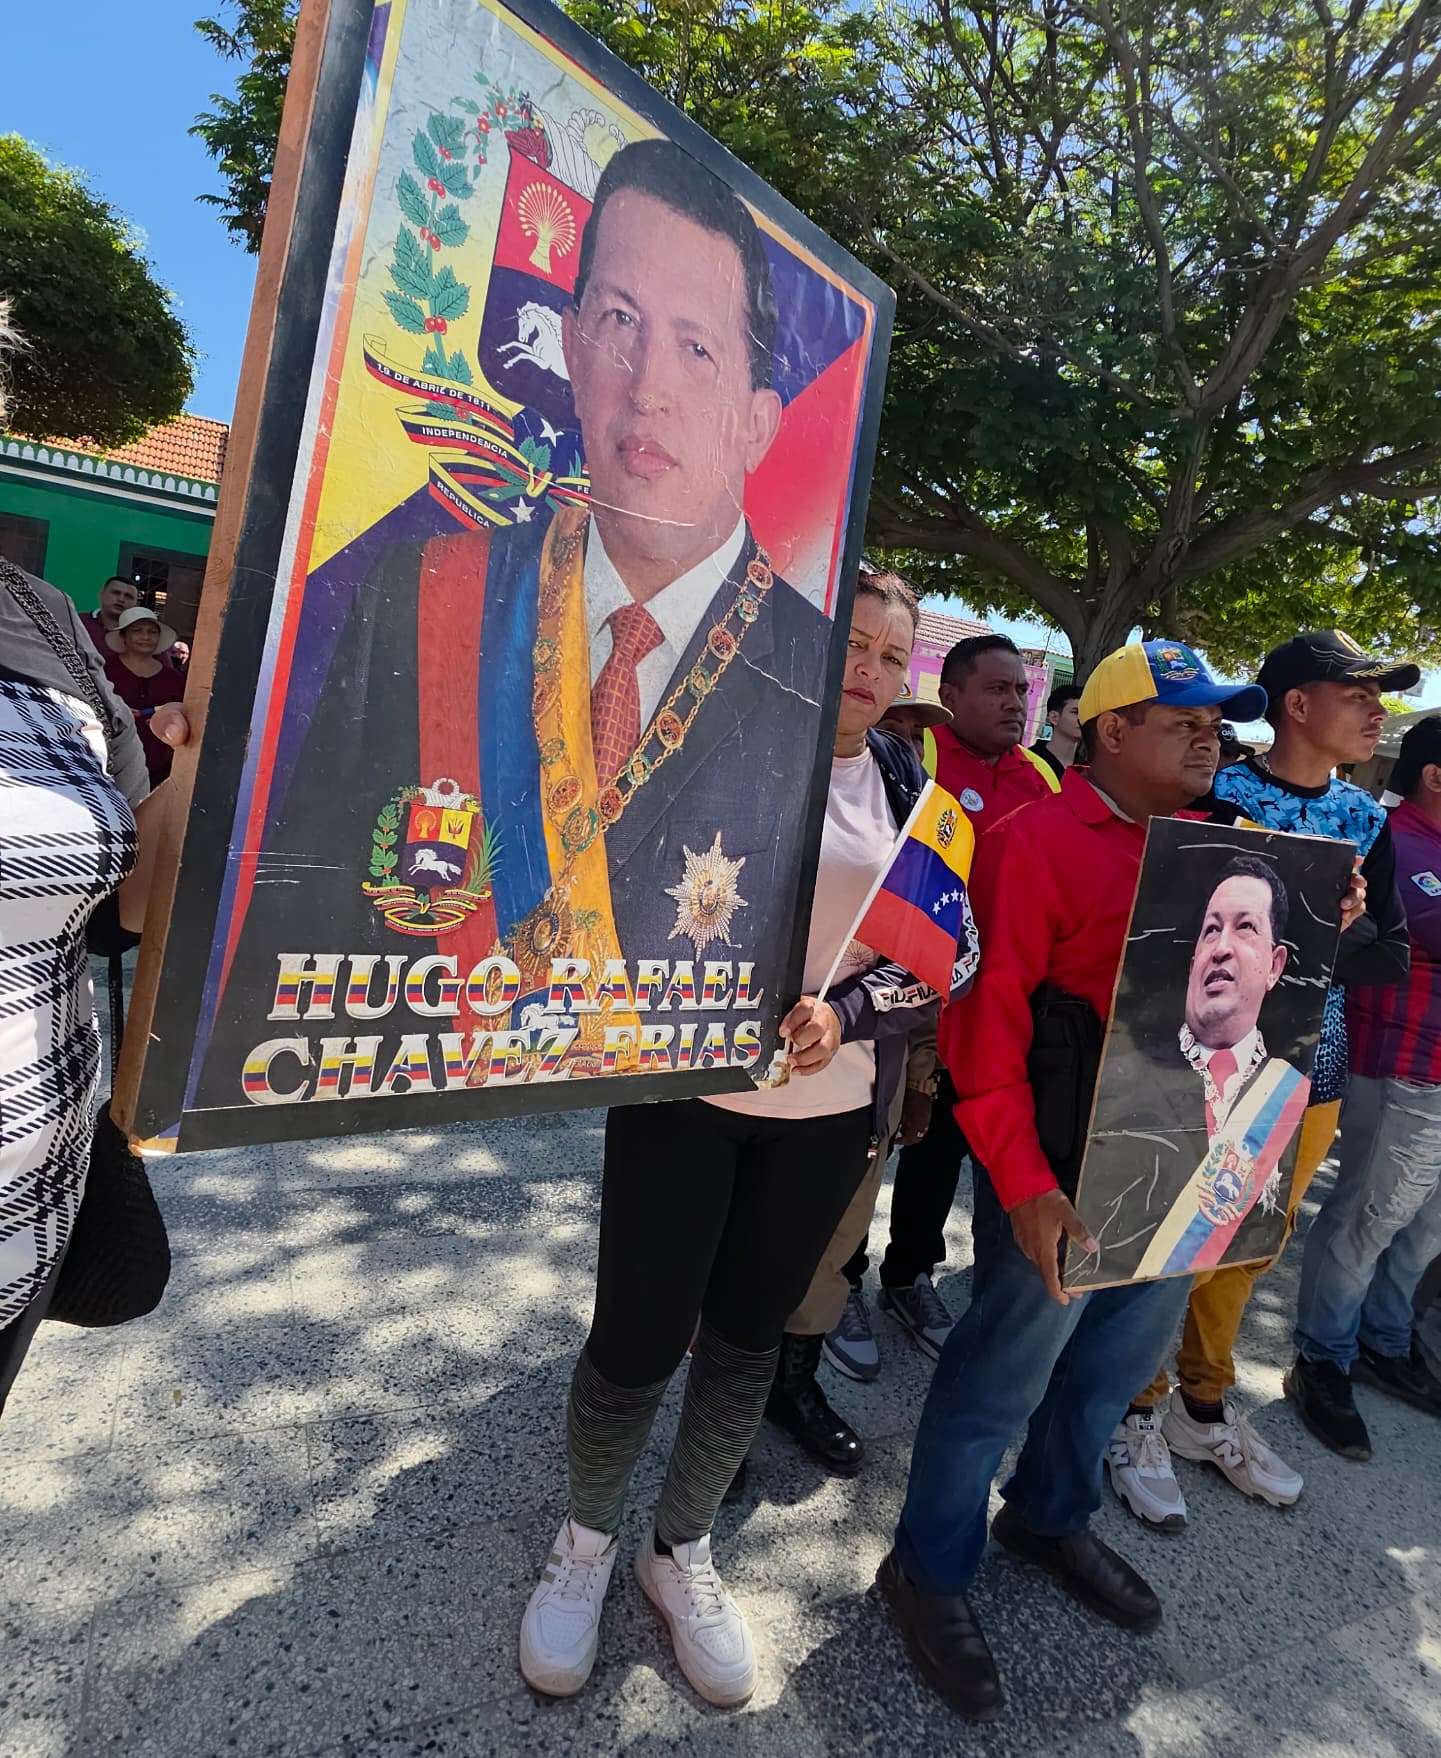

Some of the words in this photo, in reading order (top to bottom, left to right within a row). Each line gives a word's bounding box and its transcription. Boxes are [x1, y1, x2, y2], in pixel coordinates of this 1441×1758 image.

[394, 373, 410, 385] DE
[412, 379, 447, 395] ABRIL
[448, 388, 465, 400] DE
[421, 426, 509, 459] INDEPENDENCIA
[436, 480, 490, 529] REPUBLICA
[266, 953, 521, 1020] HUGO
[543, 958, 765, 1013] RAFAEL
[241, 1026, 579, 1104] CHAVEZ
[601, 1021, 763, 1070] FRIAS
